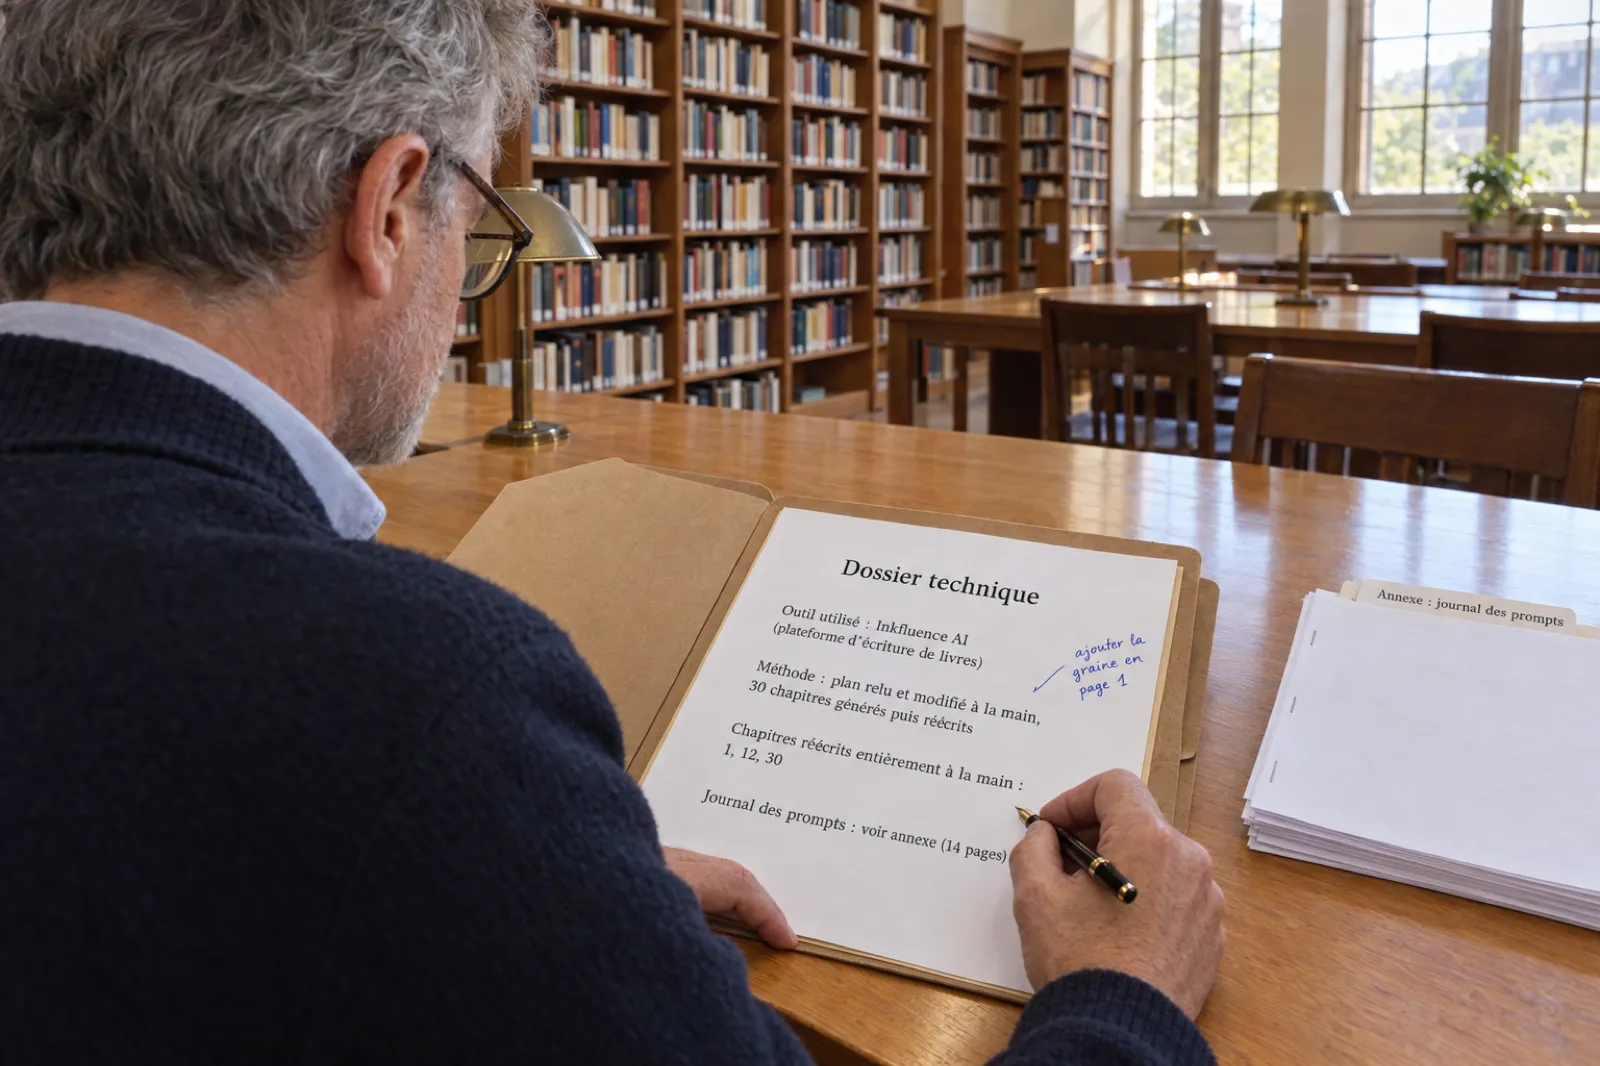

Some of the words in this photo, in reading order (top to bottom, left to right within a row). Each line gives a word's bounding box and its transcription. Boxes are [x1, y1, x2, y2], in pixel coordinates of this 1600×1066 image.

[840, 559, 923, 586] Dossier
[928, 574, 1040, 607] technique
[781, 605, 816, 620] Outil
[819, 613, 860, 628] utilisé
[875, 620, 948, 643] Inkfluence
[950, 633, 969, 646] AI
[1377, 589, 1423, 605] Annexe
[1434, 597, 1481, 614] journal
[1485, 605, 1507, 618] des
[1510, 611, 1564, 627] prompts
[773, 621, 845, 644] (plateforme
[918, 646, 935, 660] de
[938, 649, 983, 671] livres)
[1075, 638, 1124, 662] ajouter
[1130, 633, 1146, 646] la
[1072, 660, 1119, 683] graine
[1125, 655, 1144, 665] en
[1079, 681, 1110, 701] page
[1117, 673, 1128, 687] 1
[748, 679, 767, 693] 30
[769, 684, 832, 707] chapitres
[834, 698, 887, 717] générés
[889, 710, 920, 724] puis
[923, 715, 973, 734] réécrits
[756, 660, 816, 682] Méthode
[829, 675, 861, 691] plan
[864, 683, 893, 697] relu
[896, 689, 910, 701] et
[912, 692, 967, 711] modifié
[970, 700, 979, 713] à
[983, 702, 997, 716] la
[1000, 709, 1040, 727] main,
[723, 743, 734, 758] 1,
[740, 747, 760, 764] 12,
[764, 751, 783, 766] 30
[731, 722, 797, 746] Chapitres
[800, 737, 852, 758] réécrits
[855, 751, 942, 776] entièrement
[945, 764, 953, 778] à
[958, 766, 972, 782] la
[976, 774, 1013, 789] main
[700, 789, 756, 812] Journal
[758, 801, 783, 818] des
[784, 810, 846, 832] prompts
[861, 825, 888, 839] voir
[890, 831, 937, 849] annexe
[941, 838, 961, 854] (14
[964, 846, 1007, 864] pages)
